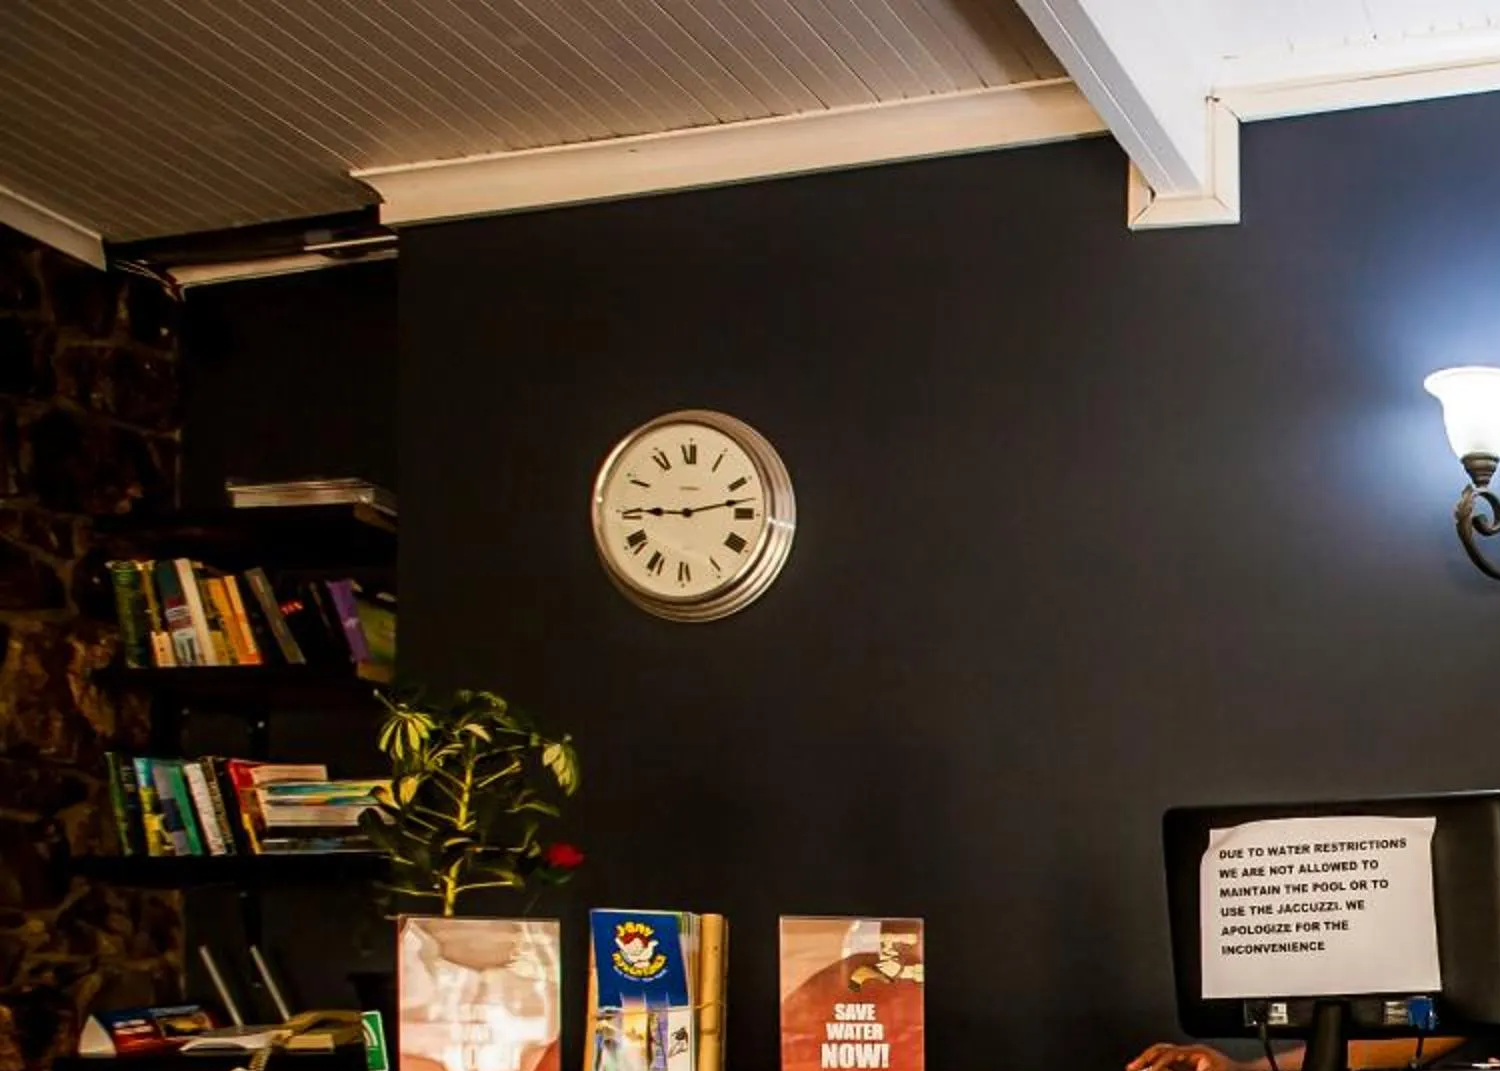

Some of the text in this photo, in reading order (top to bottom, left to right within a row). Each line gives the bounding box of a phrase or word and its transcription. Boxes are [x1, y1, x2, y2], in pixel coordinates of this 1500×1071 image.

[1219, 838, 1407, 860] DUE TO WATER RESTRICTIONS
[1219, 860, 1379, 878] WE ARE NOT ALLOWED TO
[1220, 879, 1389, 898] MAINTAIN THE POOL OR TO
[1220, 900, 1365, 917] USE THE JACCUZZI. WE
[1221, 920, 1350, 936] APOLOGIZE FOR THE
[1221, 941, 1325, 956] INCONVENIENCE
[834, 1003, 876, 1021] SAVE
[826, 1023, 884, 1040] WATER
[822, 1043, 890, 1069] NOW!
